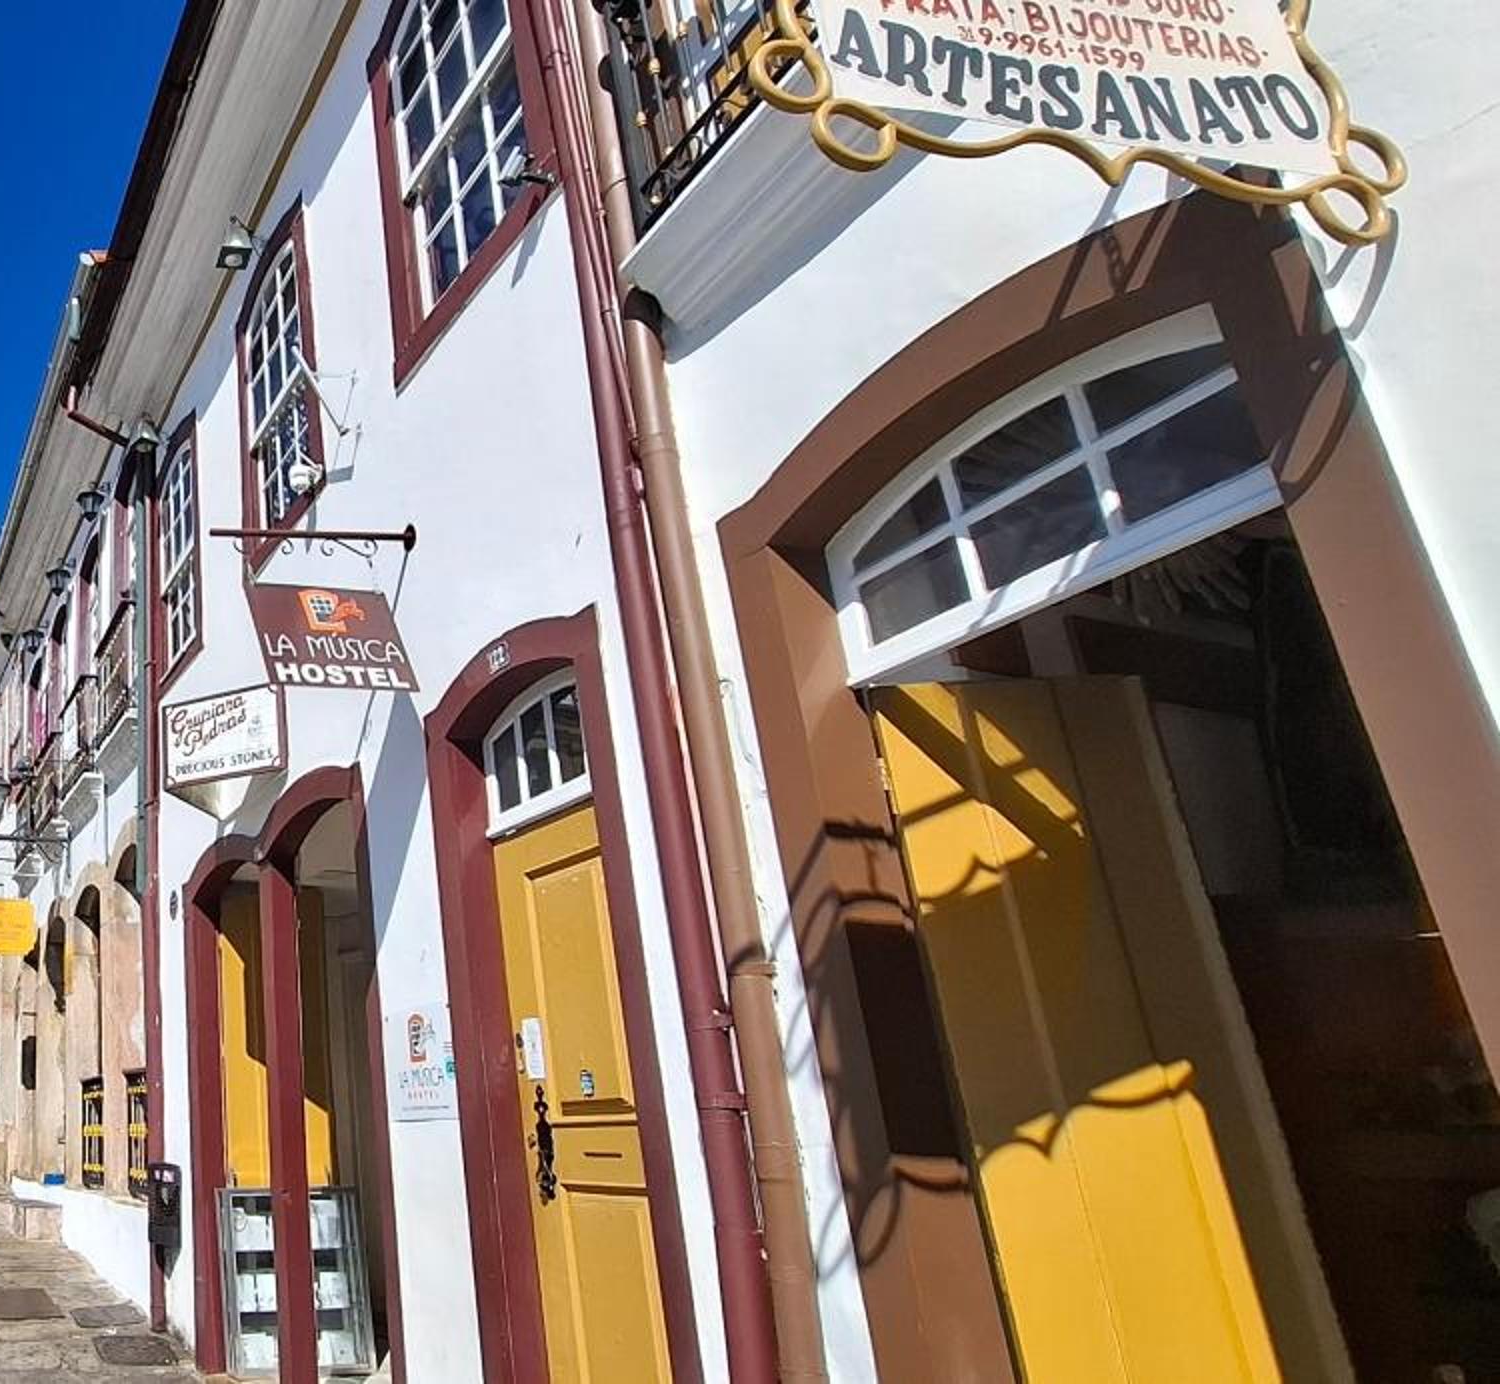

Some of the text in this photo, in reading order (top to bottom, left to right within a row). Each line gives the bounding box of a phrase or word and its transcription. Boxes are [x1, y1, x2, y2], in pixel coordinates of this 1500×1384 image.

[830, 8, 1319, 144] ARTESANATO
[264, 631, 405, 663] LA MÚSICA
[274, 661, 411, 689] HOSTEL
[182, 708, 247, 757] Pedras
[175, 748, 275, 776] PRECIOUS STONES
